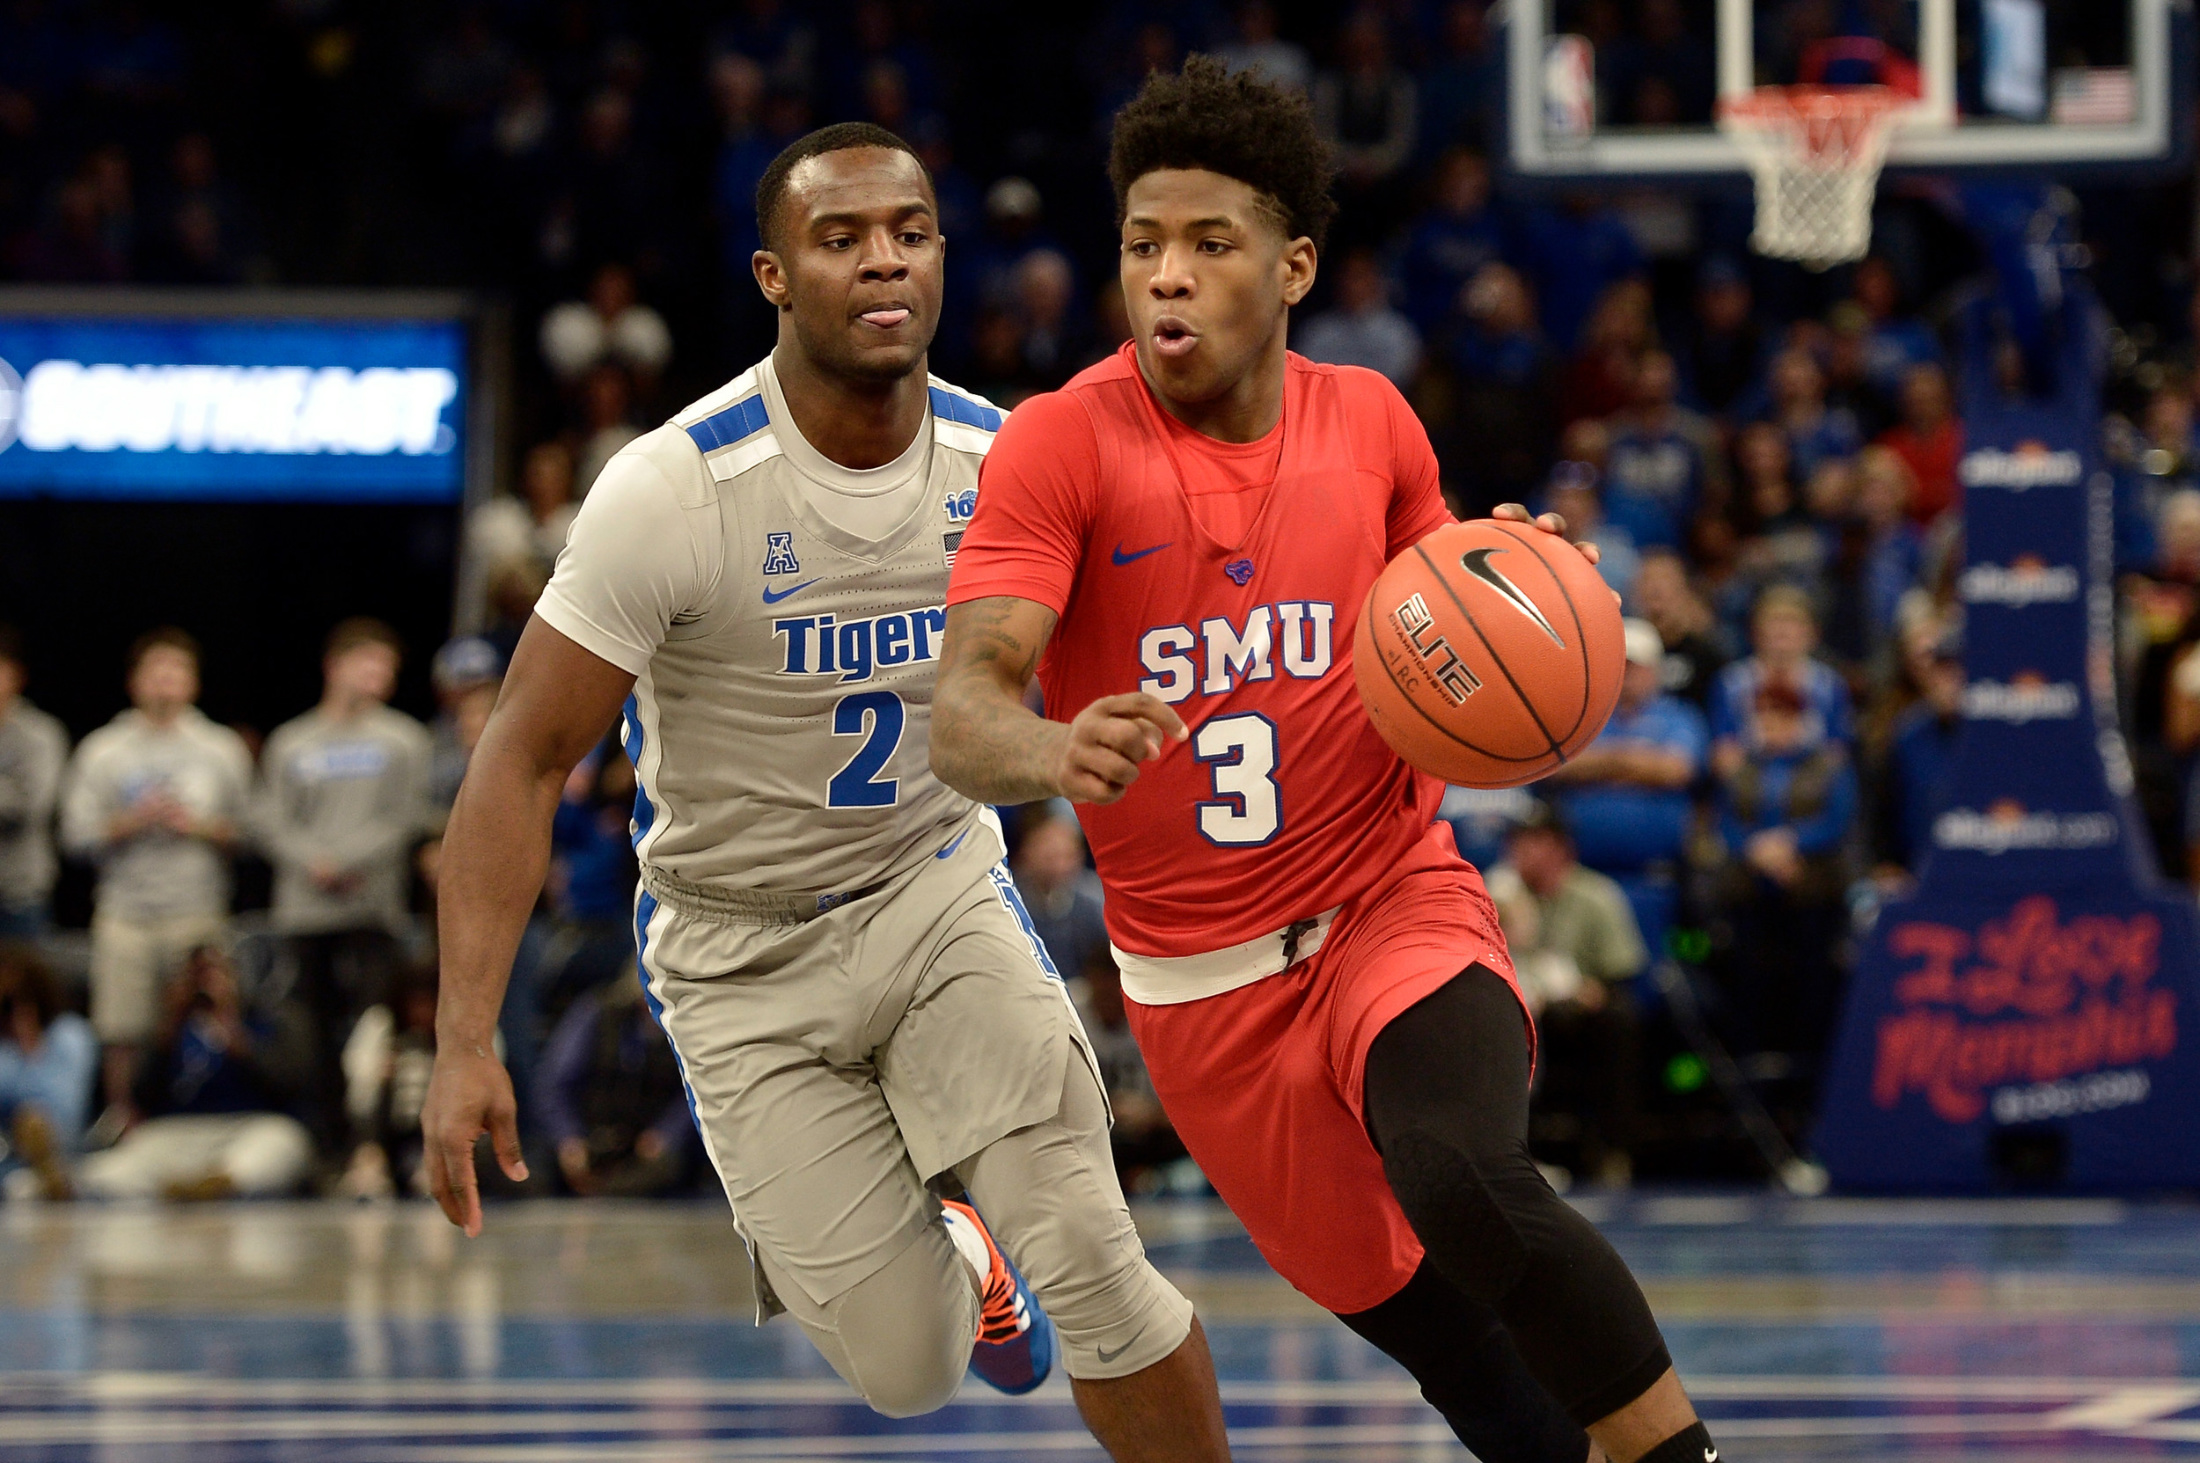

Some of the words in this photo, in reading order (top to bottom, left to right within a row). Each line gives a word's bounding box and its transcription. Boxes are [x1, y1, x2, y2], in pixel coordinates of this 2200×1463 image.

[772, 604, 946, 684] Tiger
[1139, 600, 1335, 705] SMU
[1388, 612, 1458, 709] CHAMPIONSHIP
[1395, 592, 1483, 704] ELITE
[826, 690, 906, 809] 2
[1191, 711, 1284, 848] 3
